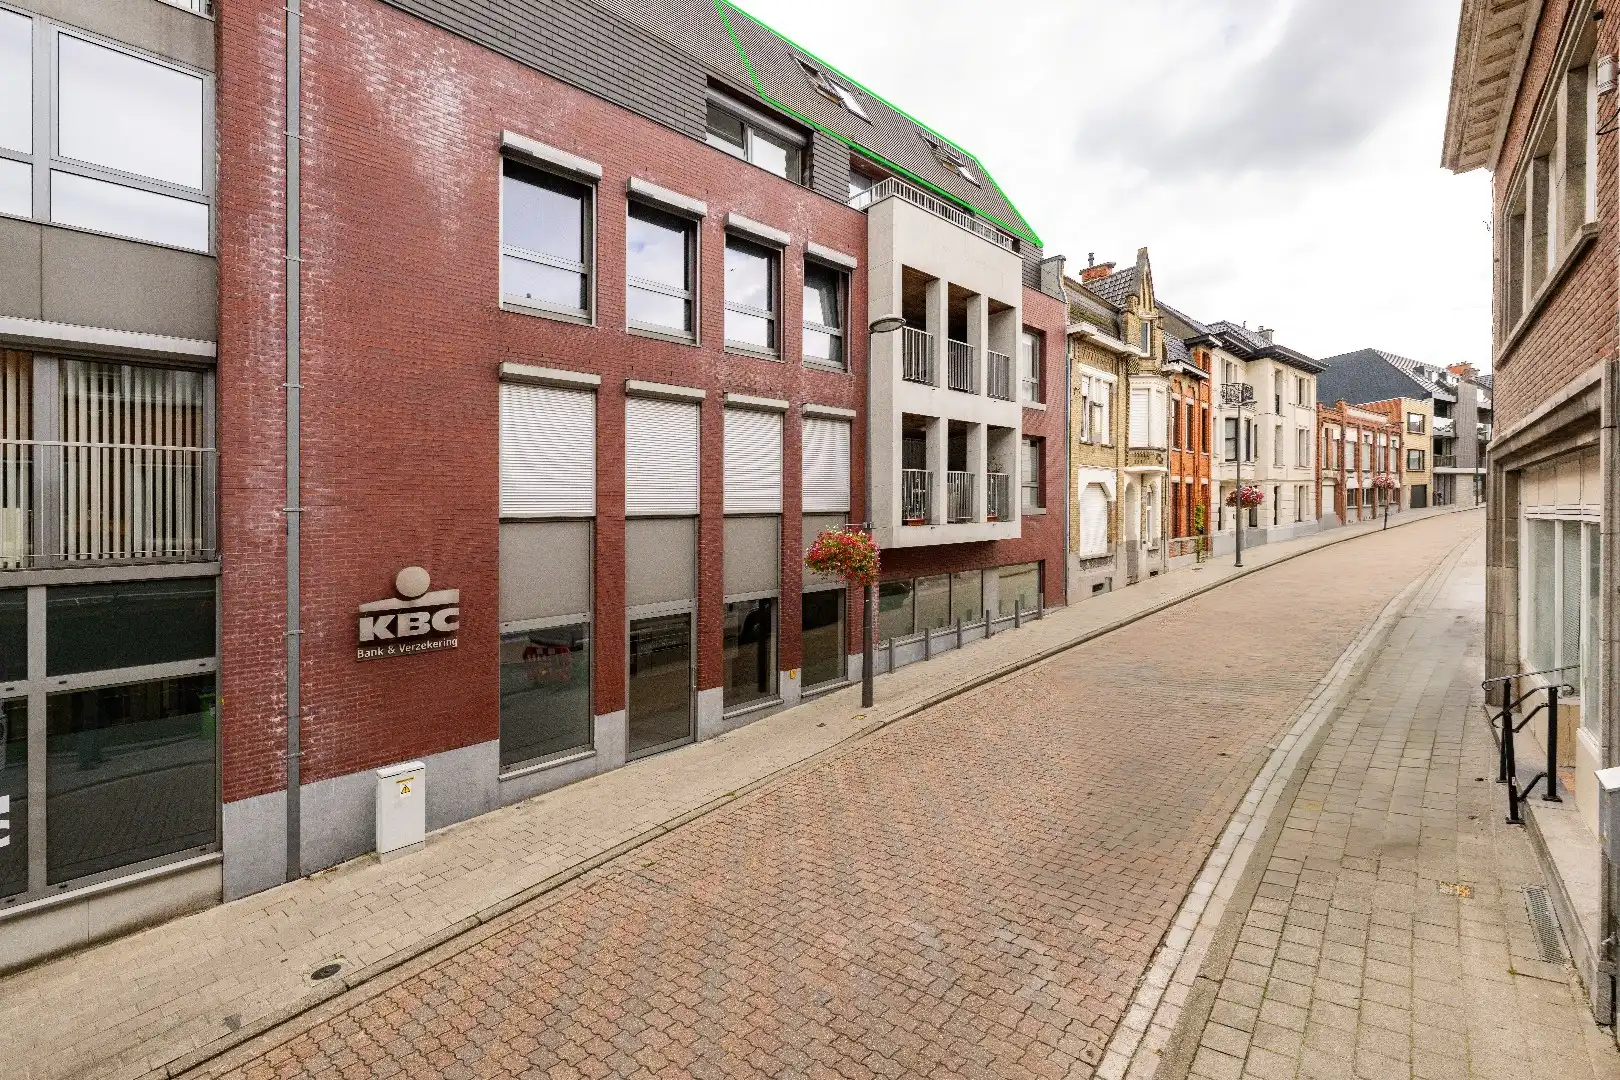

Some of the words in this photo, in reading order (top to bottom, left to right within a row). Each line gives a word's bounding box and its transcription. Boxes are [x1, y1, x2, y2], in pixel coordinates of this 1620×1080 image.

[359, 607, 460, 642] KBC
[357, 646, 384, 659] Bank
[387, 645, 396, 655] &
[399, 636, 458, 653] Verzekering
